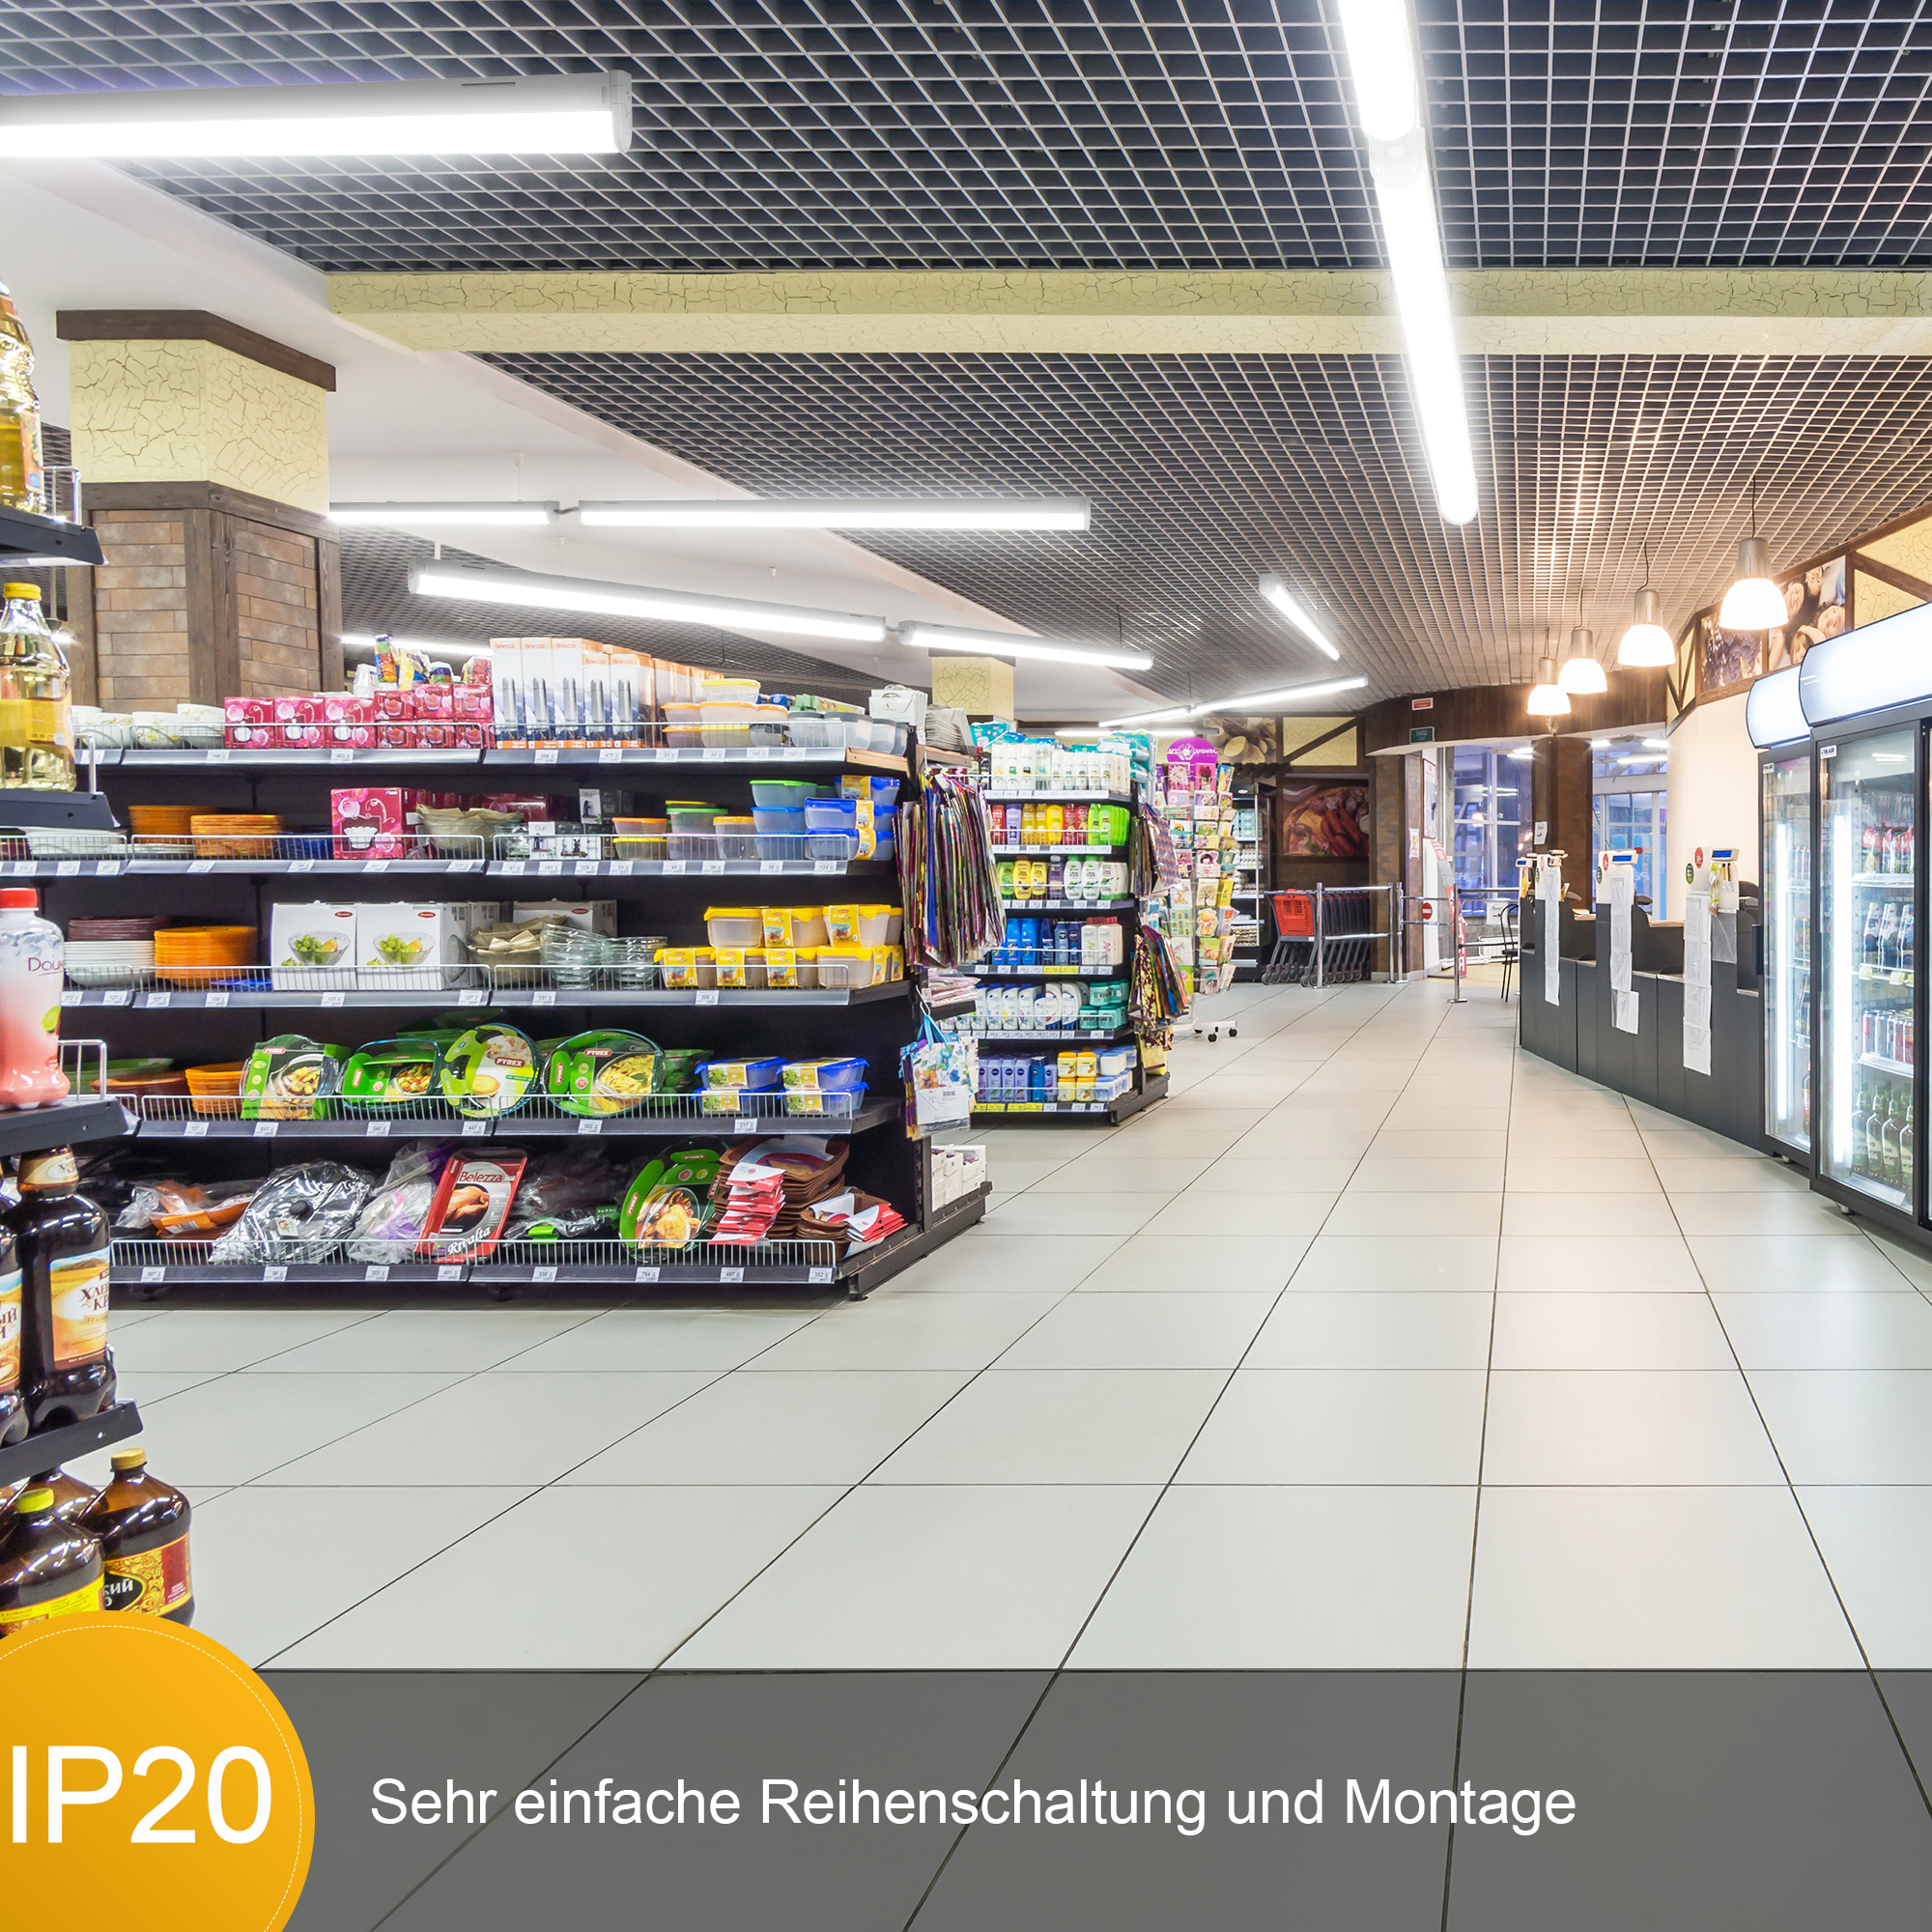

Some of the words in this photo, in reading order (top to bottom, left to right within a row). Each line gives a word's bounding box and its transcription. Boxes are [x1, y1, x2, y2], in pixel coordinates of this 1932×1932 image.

[496, 1058, 525, 1066] PYREX
[459, 1171, 503, 1183] Belezza
[447, 1226, 491, 1255] Rivalta
